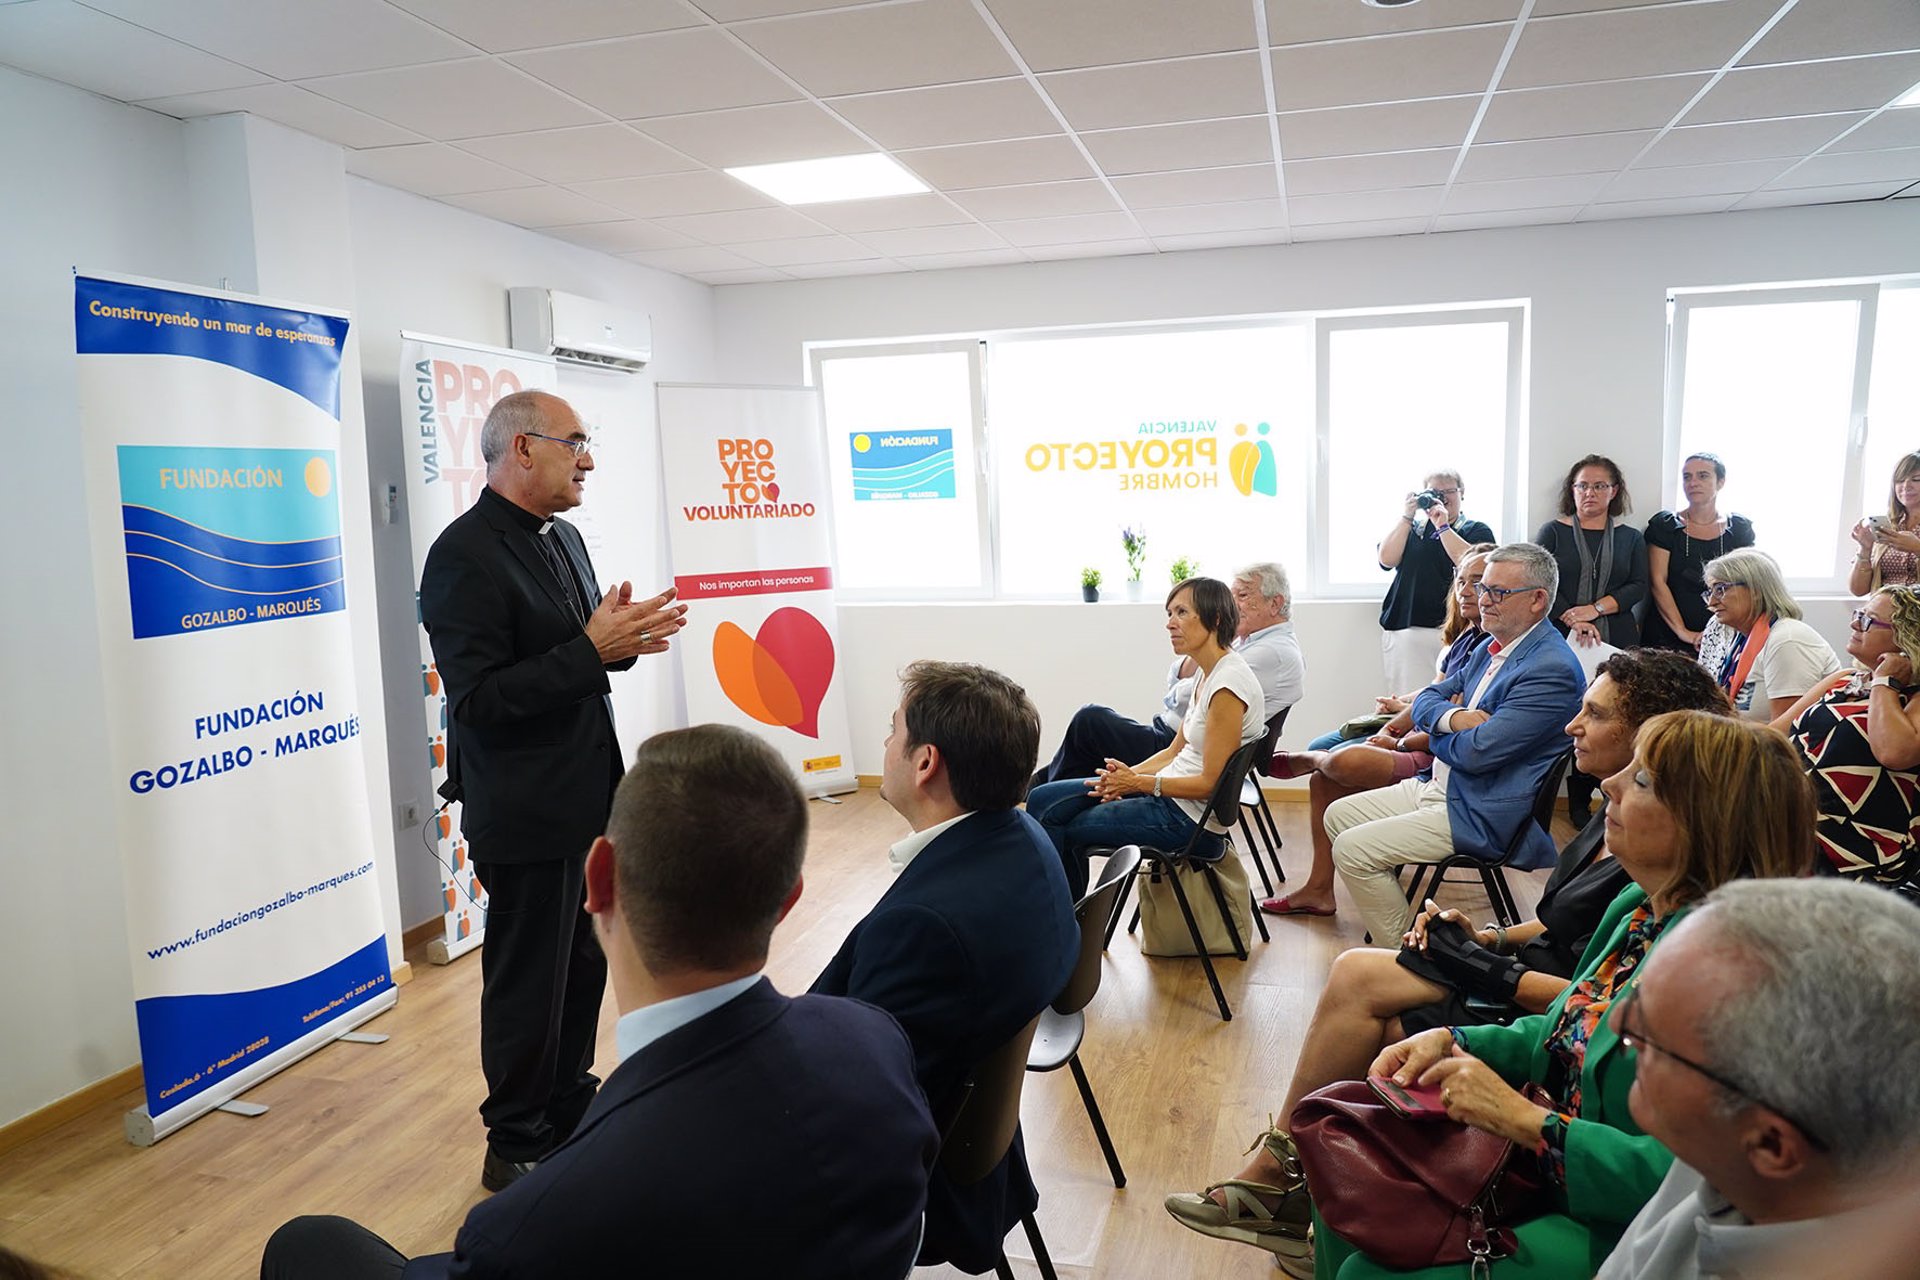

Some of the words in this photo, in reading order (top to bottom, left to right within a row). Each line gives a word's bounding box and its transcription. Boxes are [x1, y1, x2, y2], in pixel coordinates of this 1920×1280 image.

[89, 300, 199, 328] Construyendo
[203, 318, 221, 331] un
[226, 322, 252, 336] mar
[256, 322, 272, 337] de
[276, 328, 336, 347] esperanzas
[416, 359, 439, 484] VALENCIA
[718, 439, 774, 460] PRO
[160, 465, 283, 489] FUNDACIÓN
[721, 461, 776, 482] YEC
[722, 482, 760, 504] TO
[684, 503, 815, 521] VOLUNTARIADO
[700, 581, 717, 591] Nos
[719, 578, 761, 592] importan
[762, 577, 774, 587] las
[775, 575, 814, 588] personas
[181, 607, 247, 629] GOZALBO
[257, 597, 322, 618] MARQUÉS
[195, 690, 324, 740] FUNDACIÓN
[129, 746, 253, 794] GOZALBO
[275, 713, 360, 757] MARQUÉS
[147, 861, 374, 959] www.fundaciongozalbo-marques.com
[217, 1048, 245, 1069] Madrid
